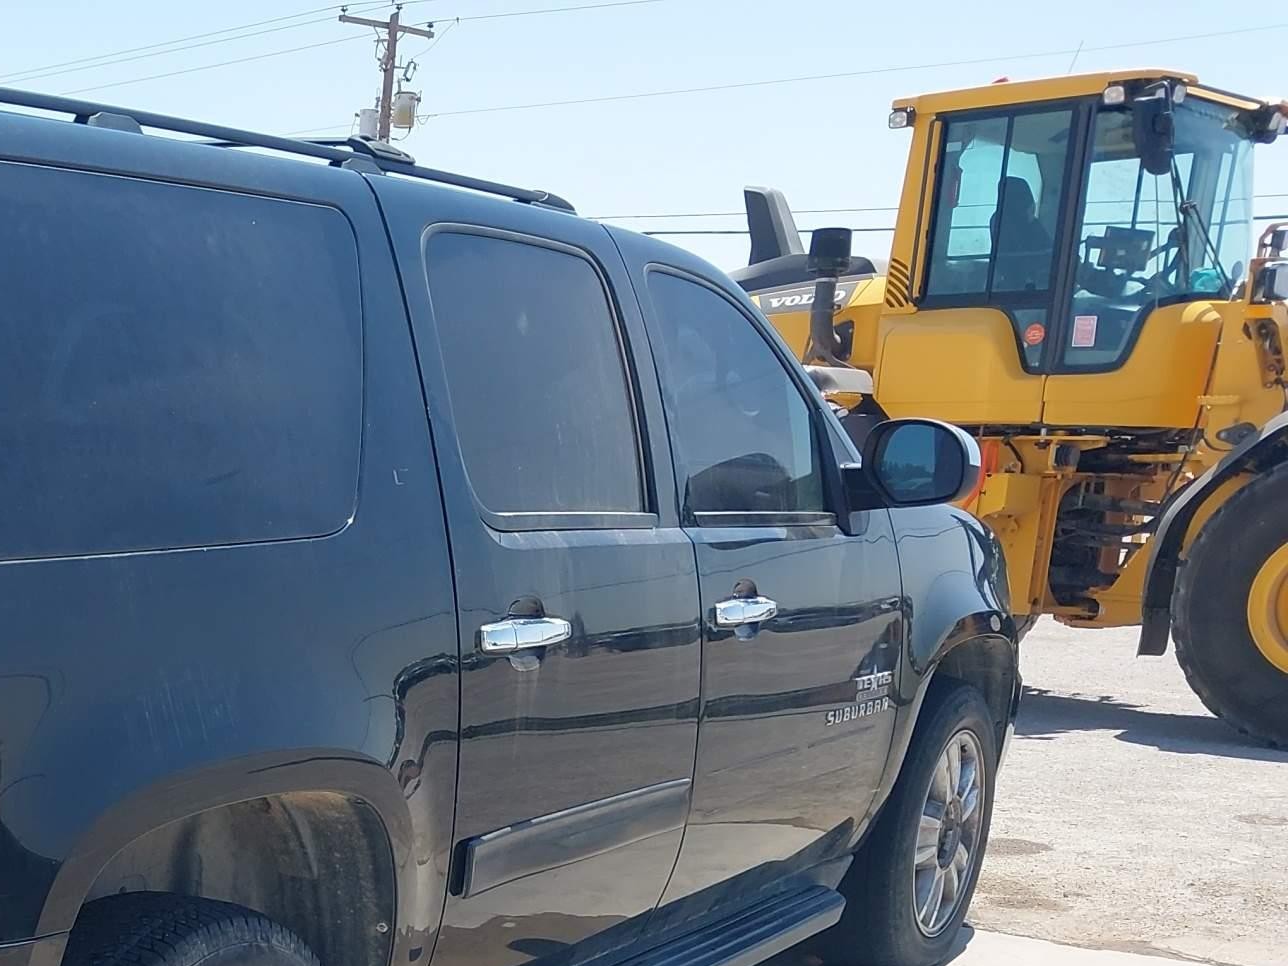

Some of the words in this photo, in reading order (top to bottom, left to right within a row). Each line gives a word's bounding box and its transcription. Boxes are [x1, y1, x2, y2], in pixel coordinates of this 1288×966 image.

[769, 290, 847, 308] VOLO
[855, 668, 893, 691] TEXAS
[826, 696, 889, 727] SUBURBAN
